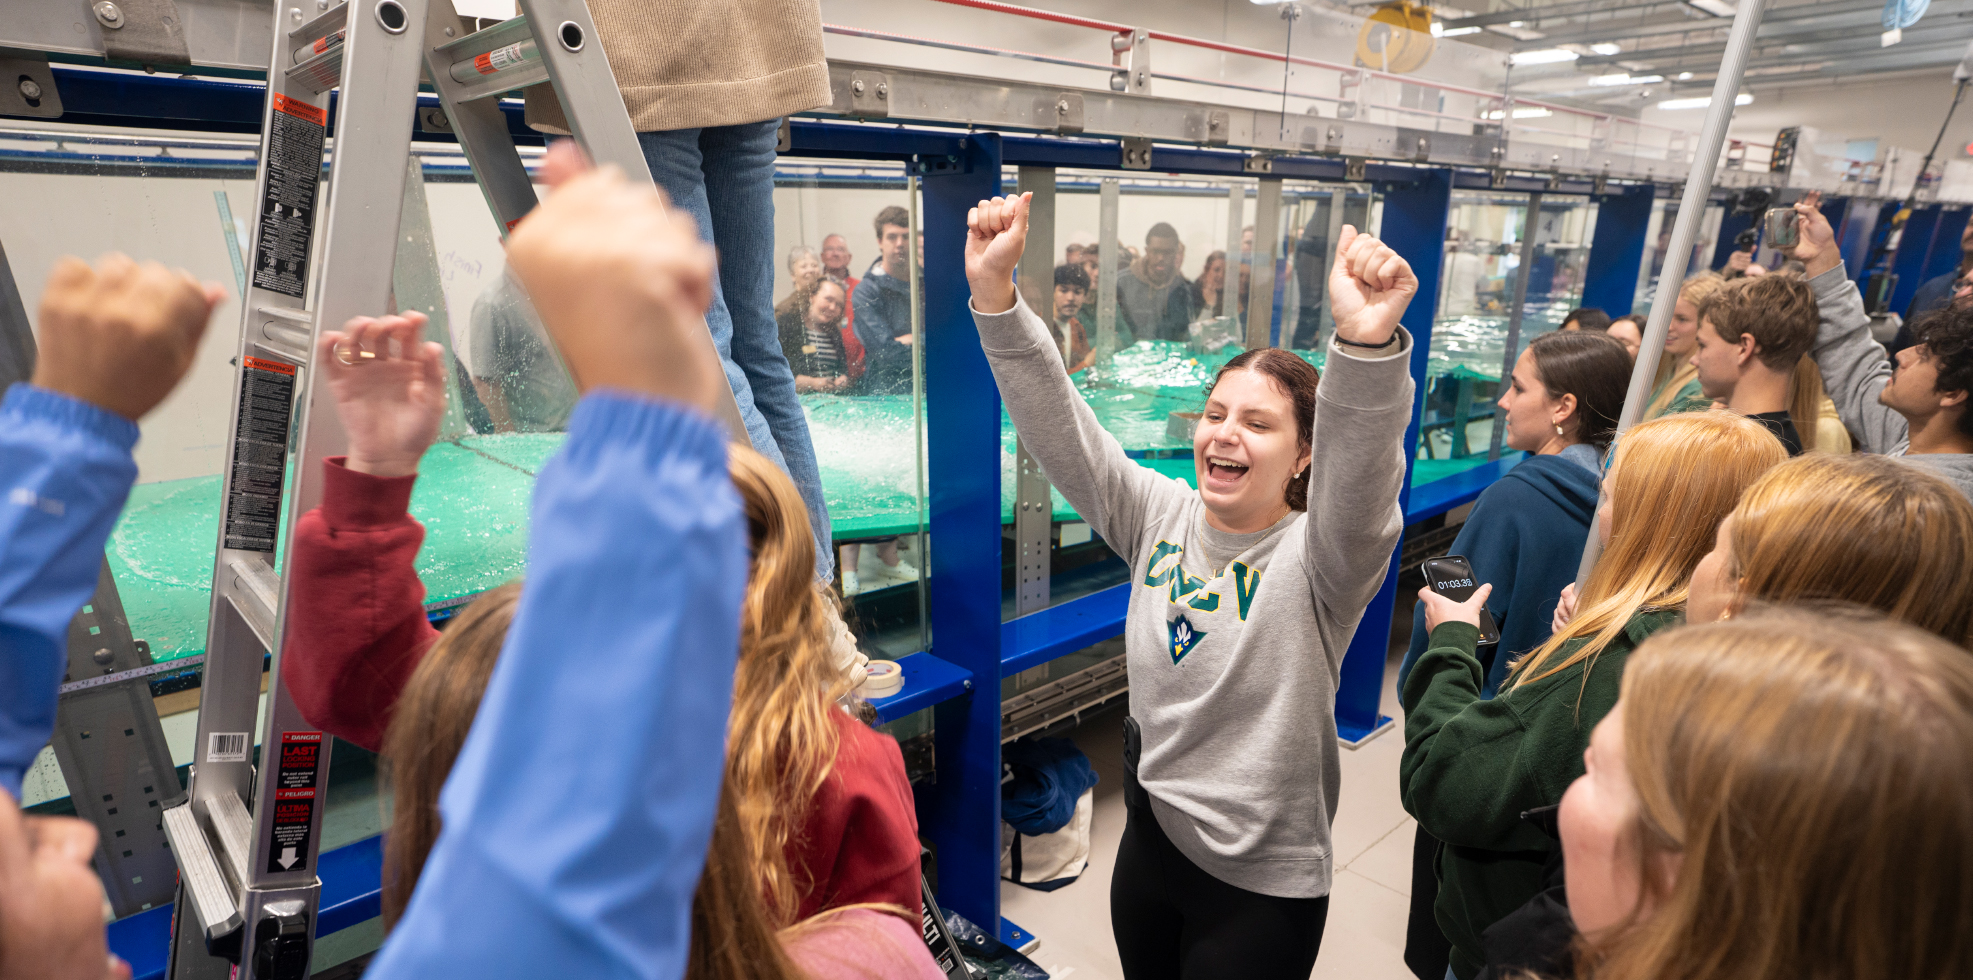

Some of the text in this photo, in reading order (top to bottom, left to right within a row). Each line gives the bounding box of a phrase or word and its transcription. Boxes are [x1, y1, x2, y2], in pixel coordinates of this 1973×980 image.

[288, 99, 319, 114] WARNING
[283, 106, 323, 124] ADVERTENCIA
[254, 361, 293, 373] ADVERTENCIA
[283, 746, 317, 756] LAST
[277, 803, 310, 813] ÚLTIMA
[921, 902, 940, 945] ULTI
